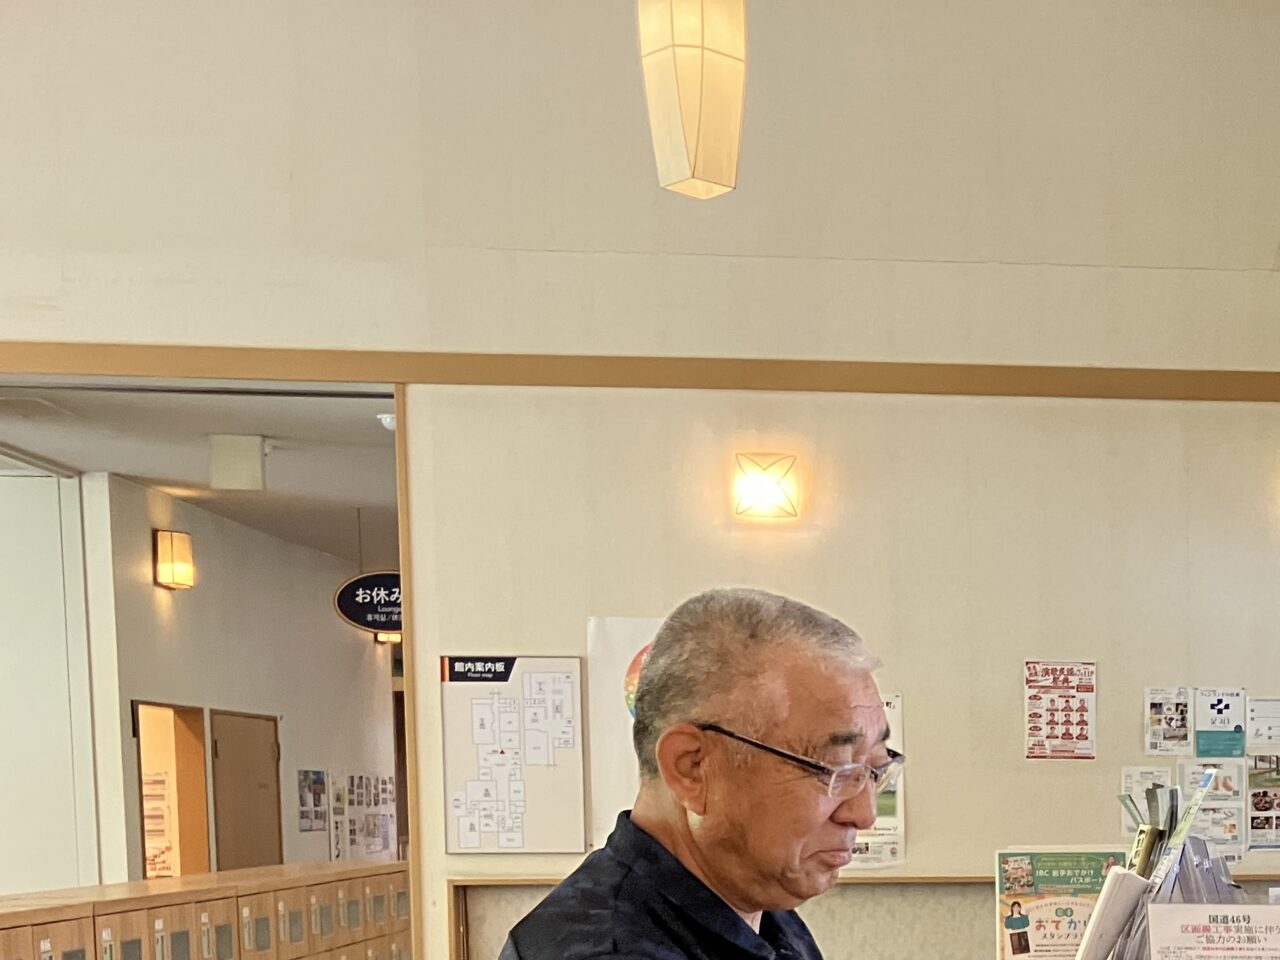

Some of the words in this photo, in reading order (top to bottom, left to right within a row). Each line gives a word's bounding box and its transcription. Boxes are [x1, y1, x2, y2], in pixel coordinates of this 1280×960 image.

[454, 661, 505, 672] 館内案内板
[1208, 914, 1251, 924] 国道46号
[1181, 925, 1280, 935] 区画線工事実施に伴う
[1195, 935, 1268, 944] ご協力のお願い
